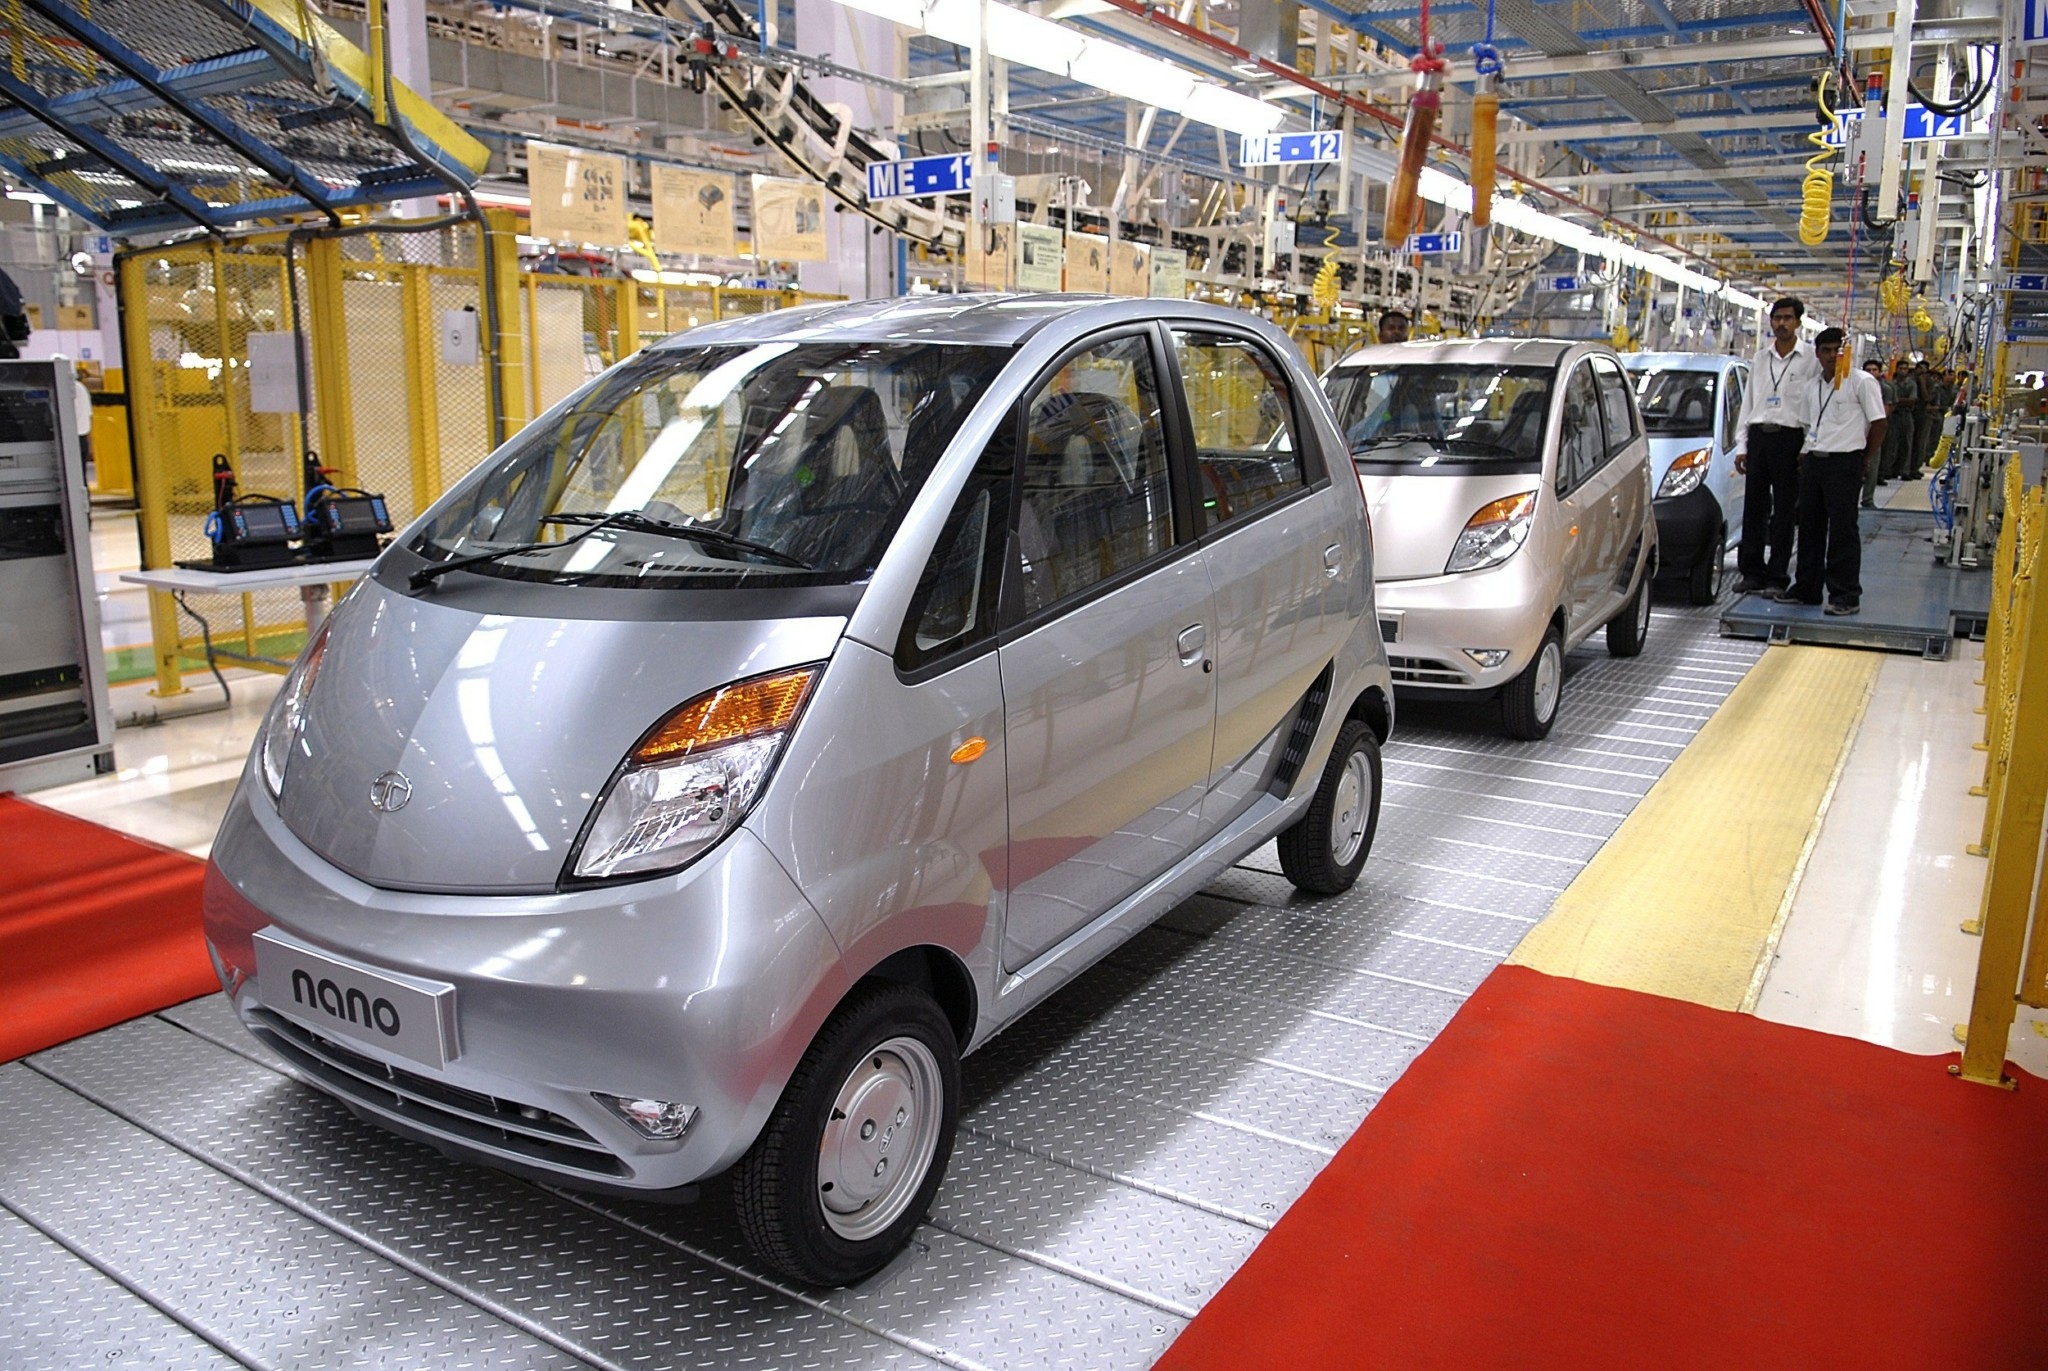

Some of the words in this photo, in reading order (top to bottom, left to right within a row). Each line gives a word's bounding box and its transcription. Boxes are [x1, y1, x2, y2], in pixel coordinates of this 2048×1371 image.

[1920, 110, 1956, 137] 12
[1246, 136, 1281, 163] ME
[1310, 133, 1337, 160] 12
[873, 162, 916, 197] ME
[1439, 232, 1455, 251] 11
[1538, 277, 1557, 291] ME
[292, 968, 401, 1037] nano
